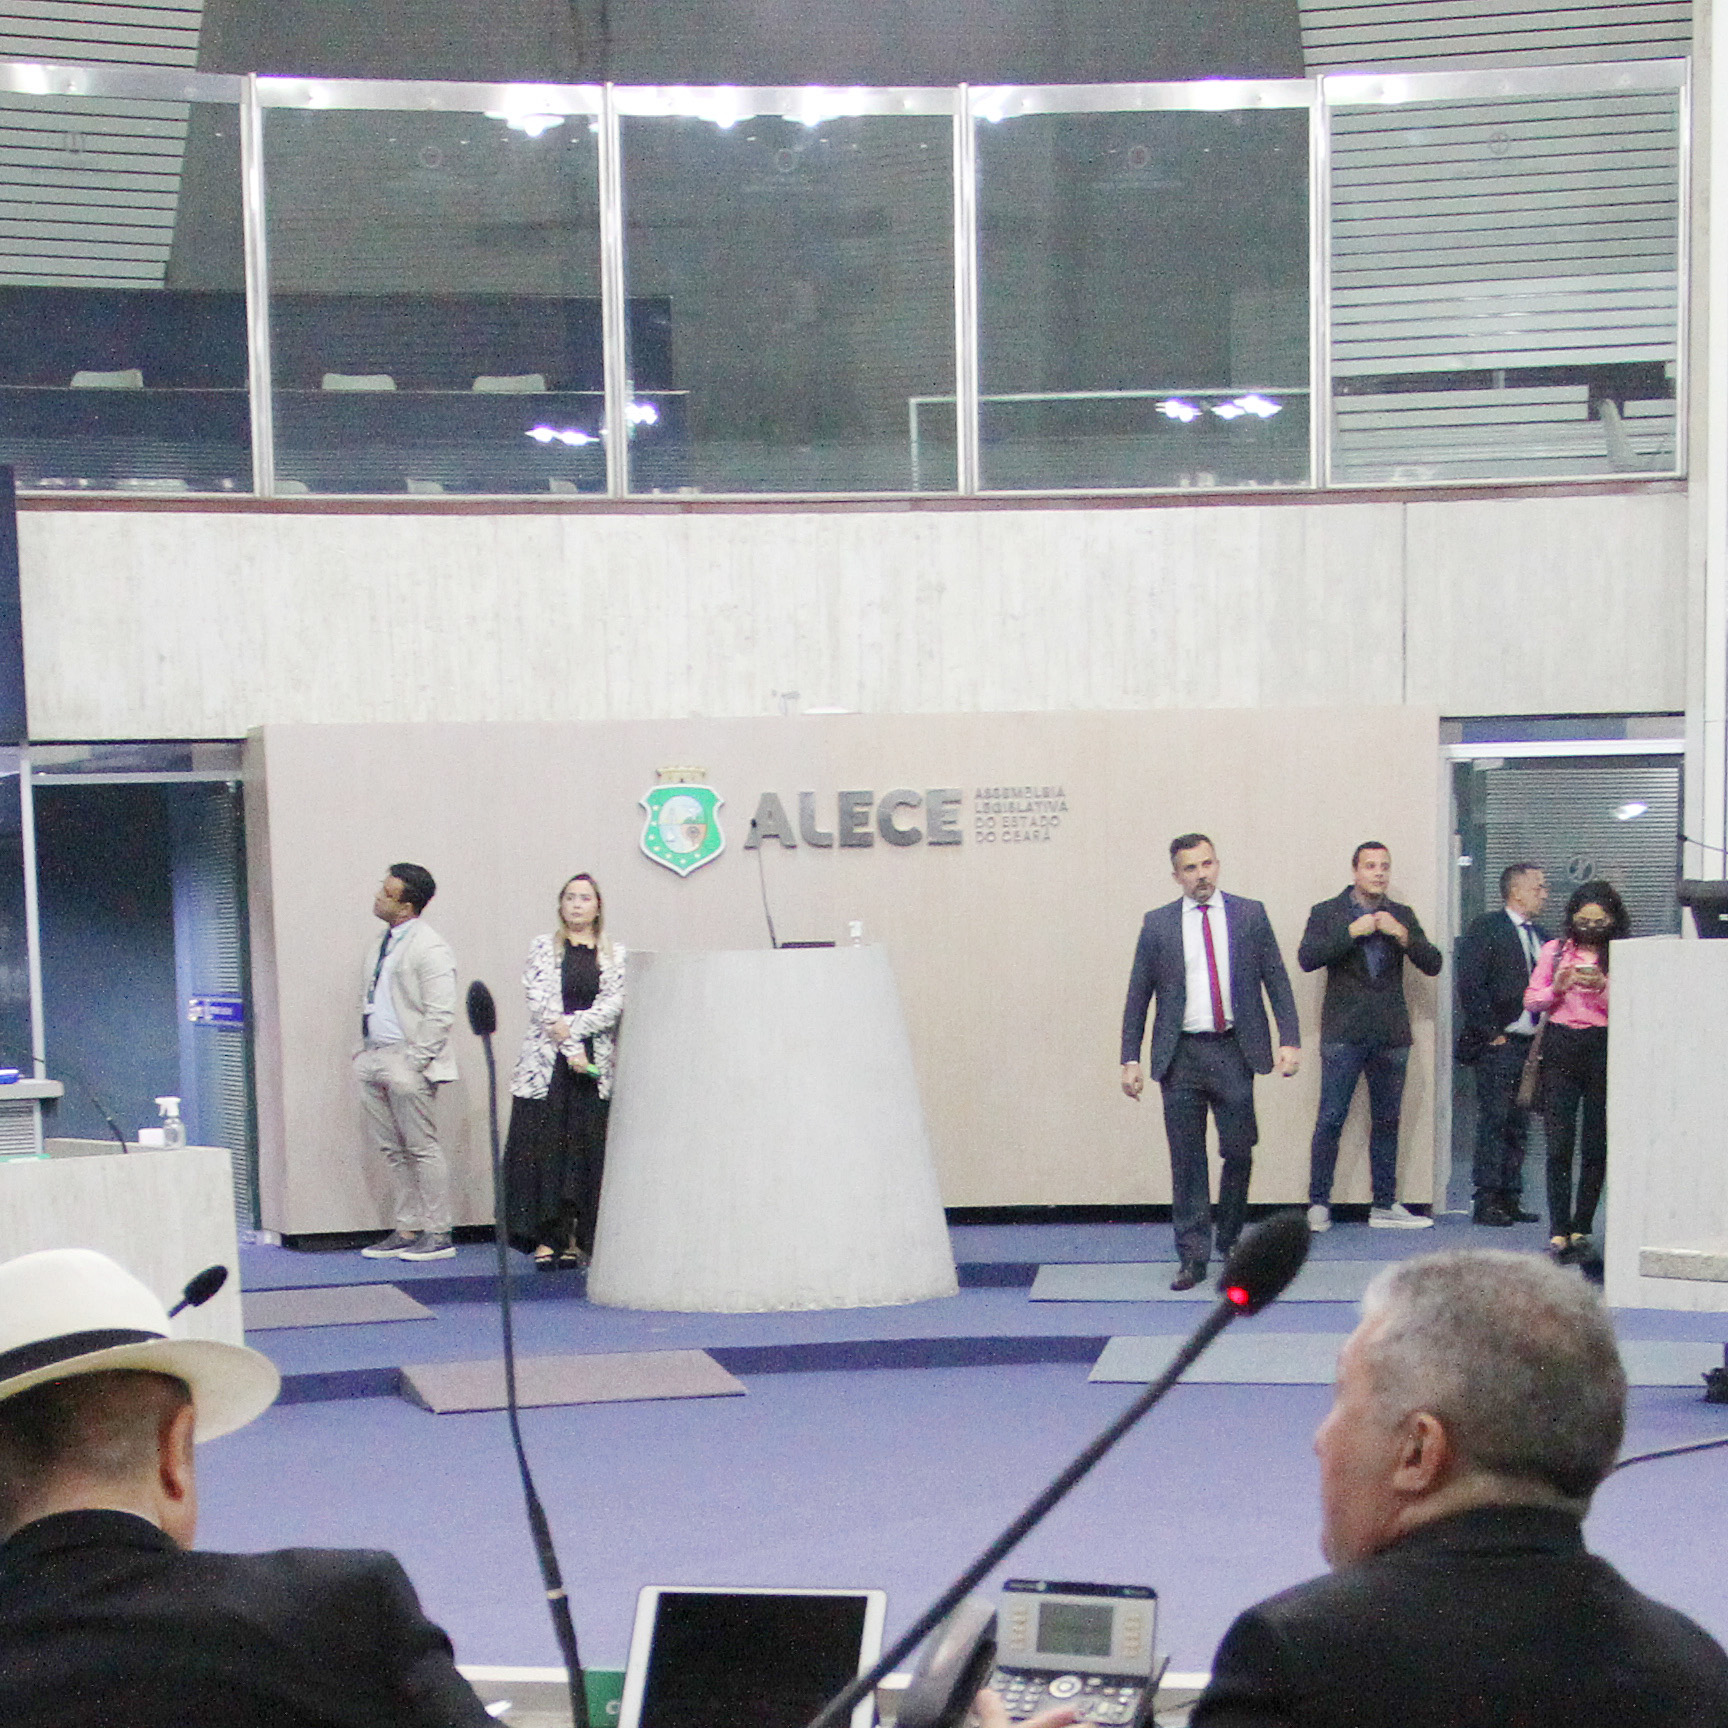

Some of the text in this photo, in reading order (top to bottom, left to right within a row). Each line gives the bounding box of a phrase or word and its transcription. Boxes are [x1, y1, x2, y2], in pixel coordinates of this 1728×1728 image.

[744, 788, 963, 849] ALECE
[975, 814, 1061, 828] DO ESTADO
[975, 830, 997, 843] DO
